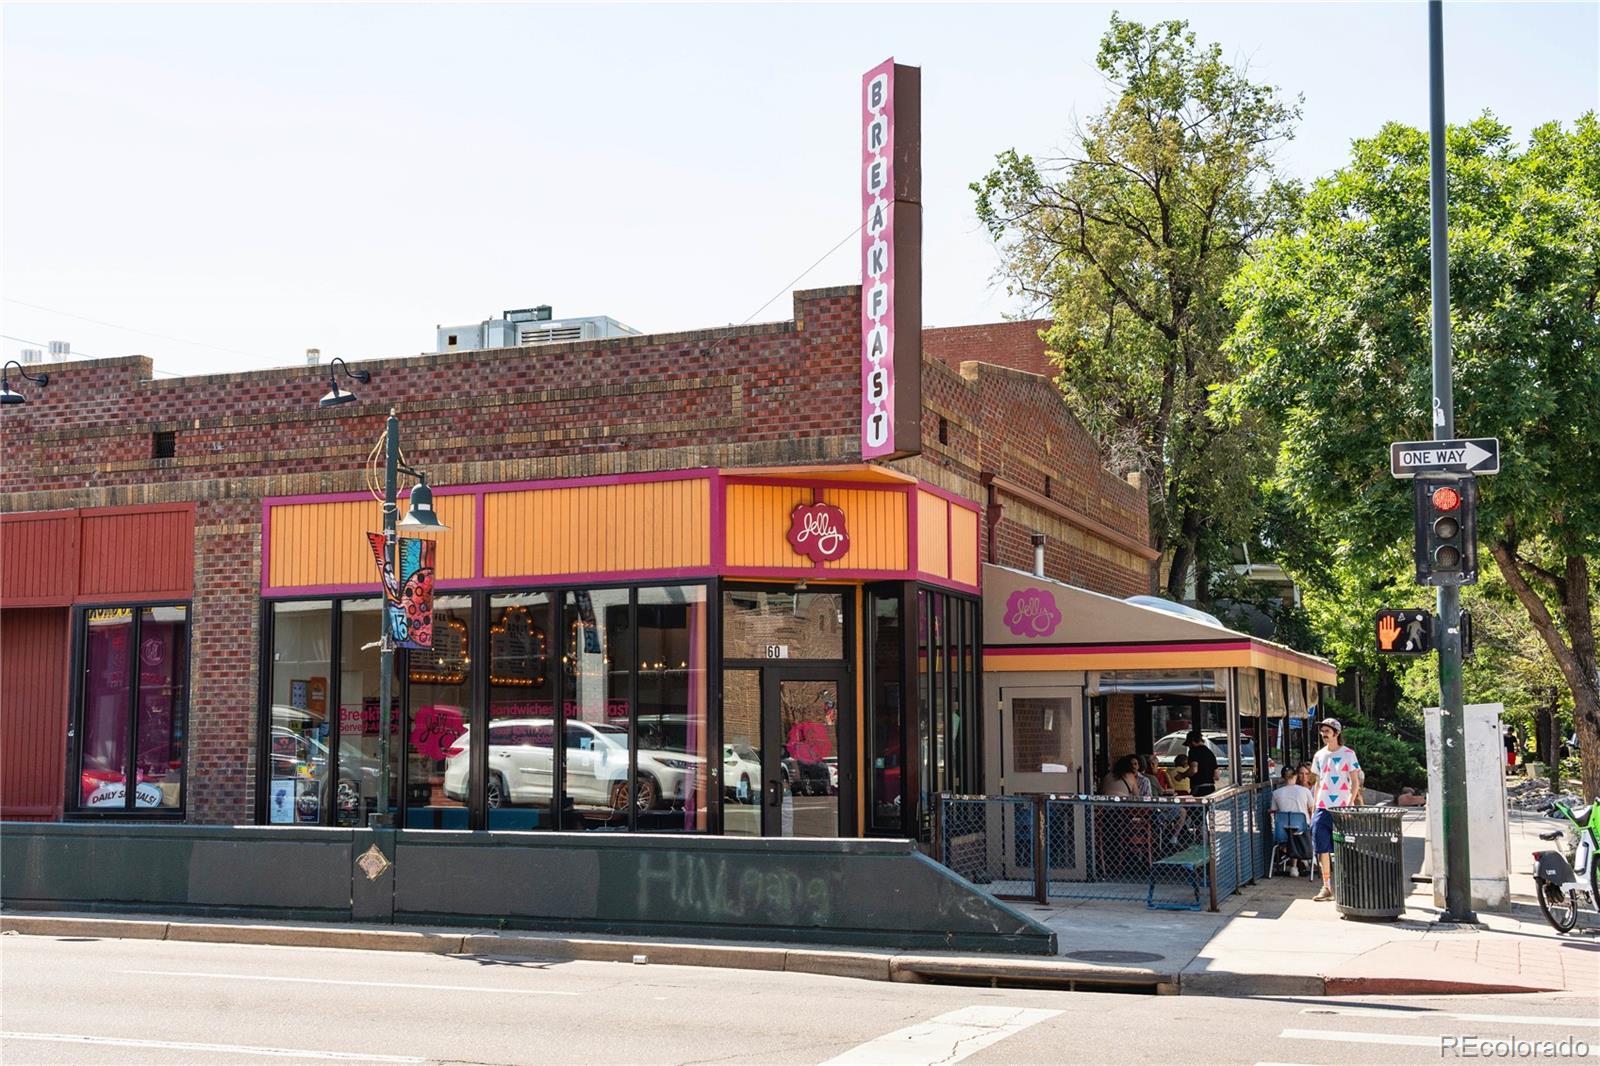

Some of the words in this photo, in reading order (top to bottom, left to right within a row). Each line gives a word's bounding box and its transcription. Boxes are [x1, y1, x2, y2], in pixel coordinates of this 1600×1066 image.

[869, 79, 885, 441] BREAKFAST
[1403, 451, 1431, 465] ONE
[1436, 449, 1465, 463] WAY
[797, 512, 844, 555] Jelly
[1012, 597, 1054, 632] Jelly
[767, 645, 780, 658] 60
[338, 706, 400, 721] Breakfst
[489, 702, 554, 716] Sandwiches
[563, 701, 629, 717] Brfast
[92, 791, 117, 804] DAILY
[117, 790, 157, 805] SIALS!
